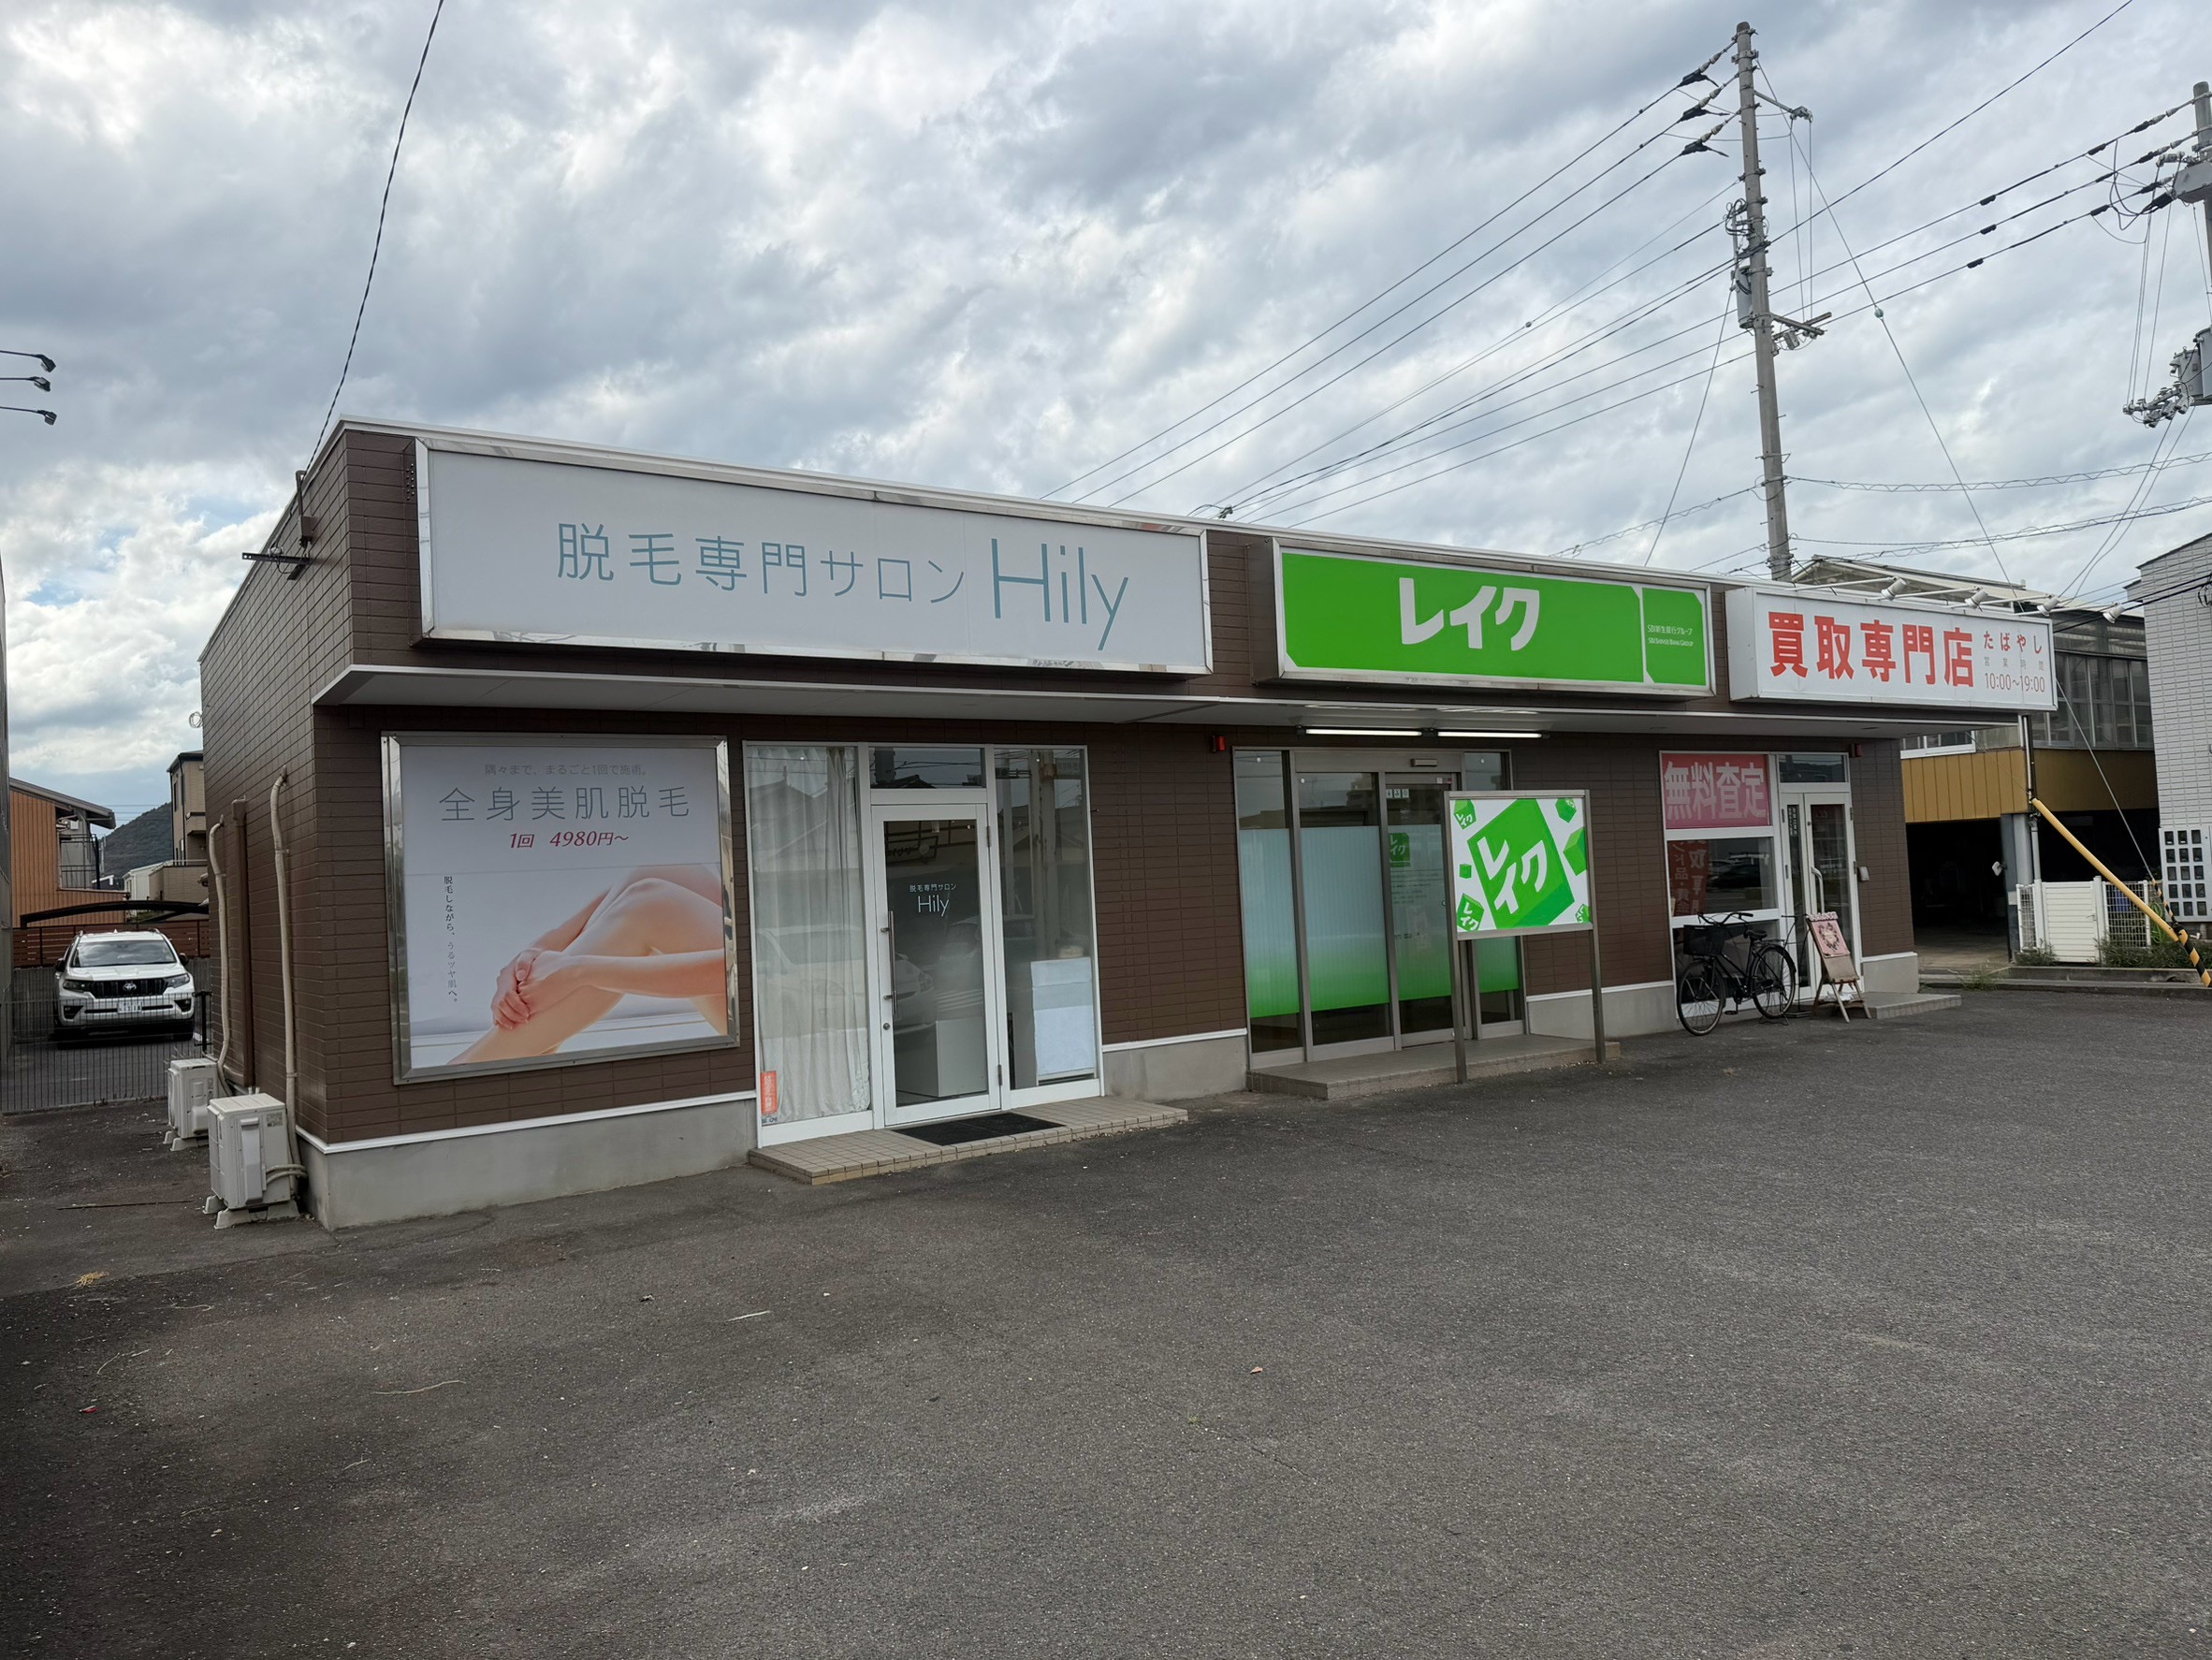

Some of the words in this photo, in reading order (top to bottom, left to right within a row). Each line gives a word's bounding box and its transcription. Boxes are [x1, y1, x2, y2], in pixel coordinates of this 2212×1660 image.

[557, 522, 965, 604] 脱毛専門サロン
[992, 538, 1128, 650] Hily
[1399, 577, 1540, 651] レイク
[1768, 611, 1974, 688] 買取専門店
[1983, 630, 2042, 654] たばやし
[439, 785, 690, 822] 全身美肌脱毛
[1664, 760, 1767, 822] 無料査定
[509, 832, 535, 849] 1回
[918, 895, 950, 917] Hily
[1477, 836, 1548, 915] レイク
